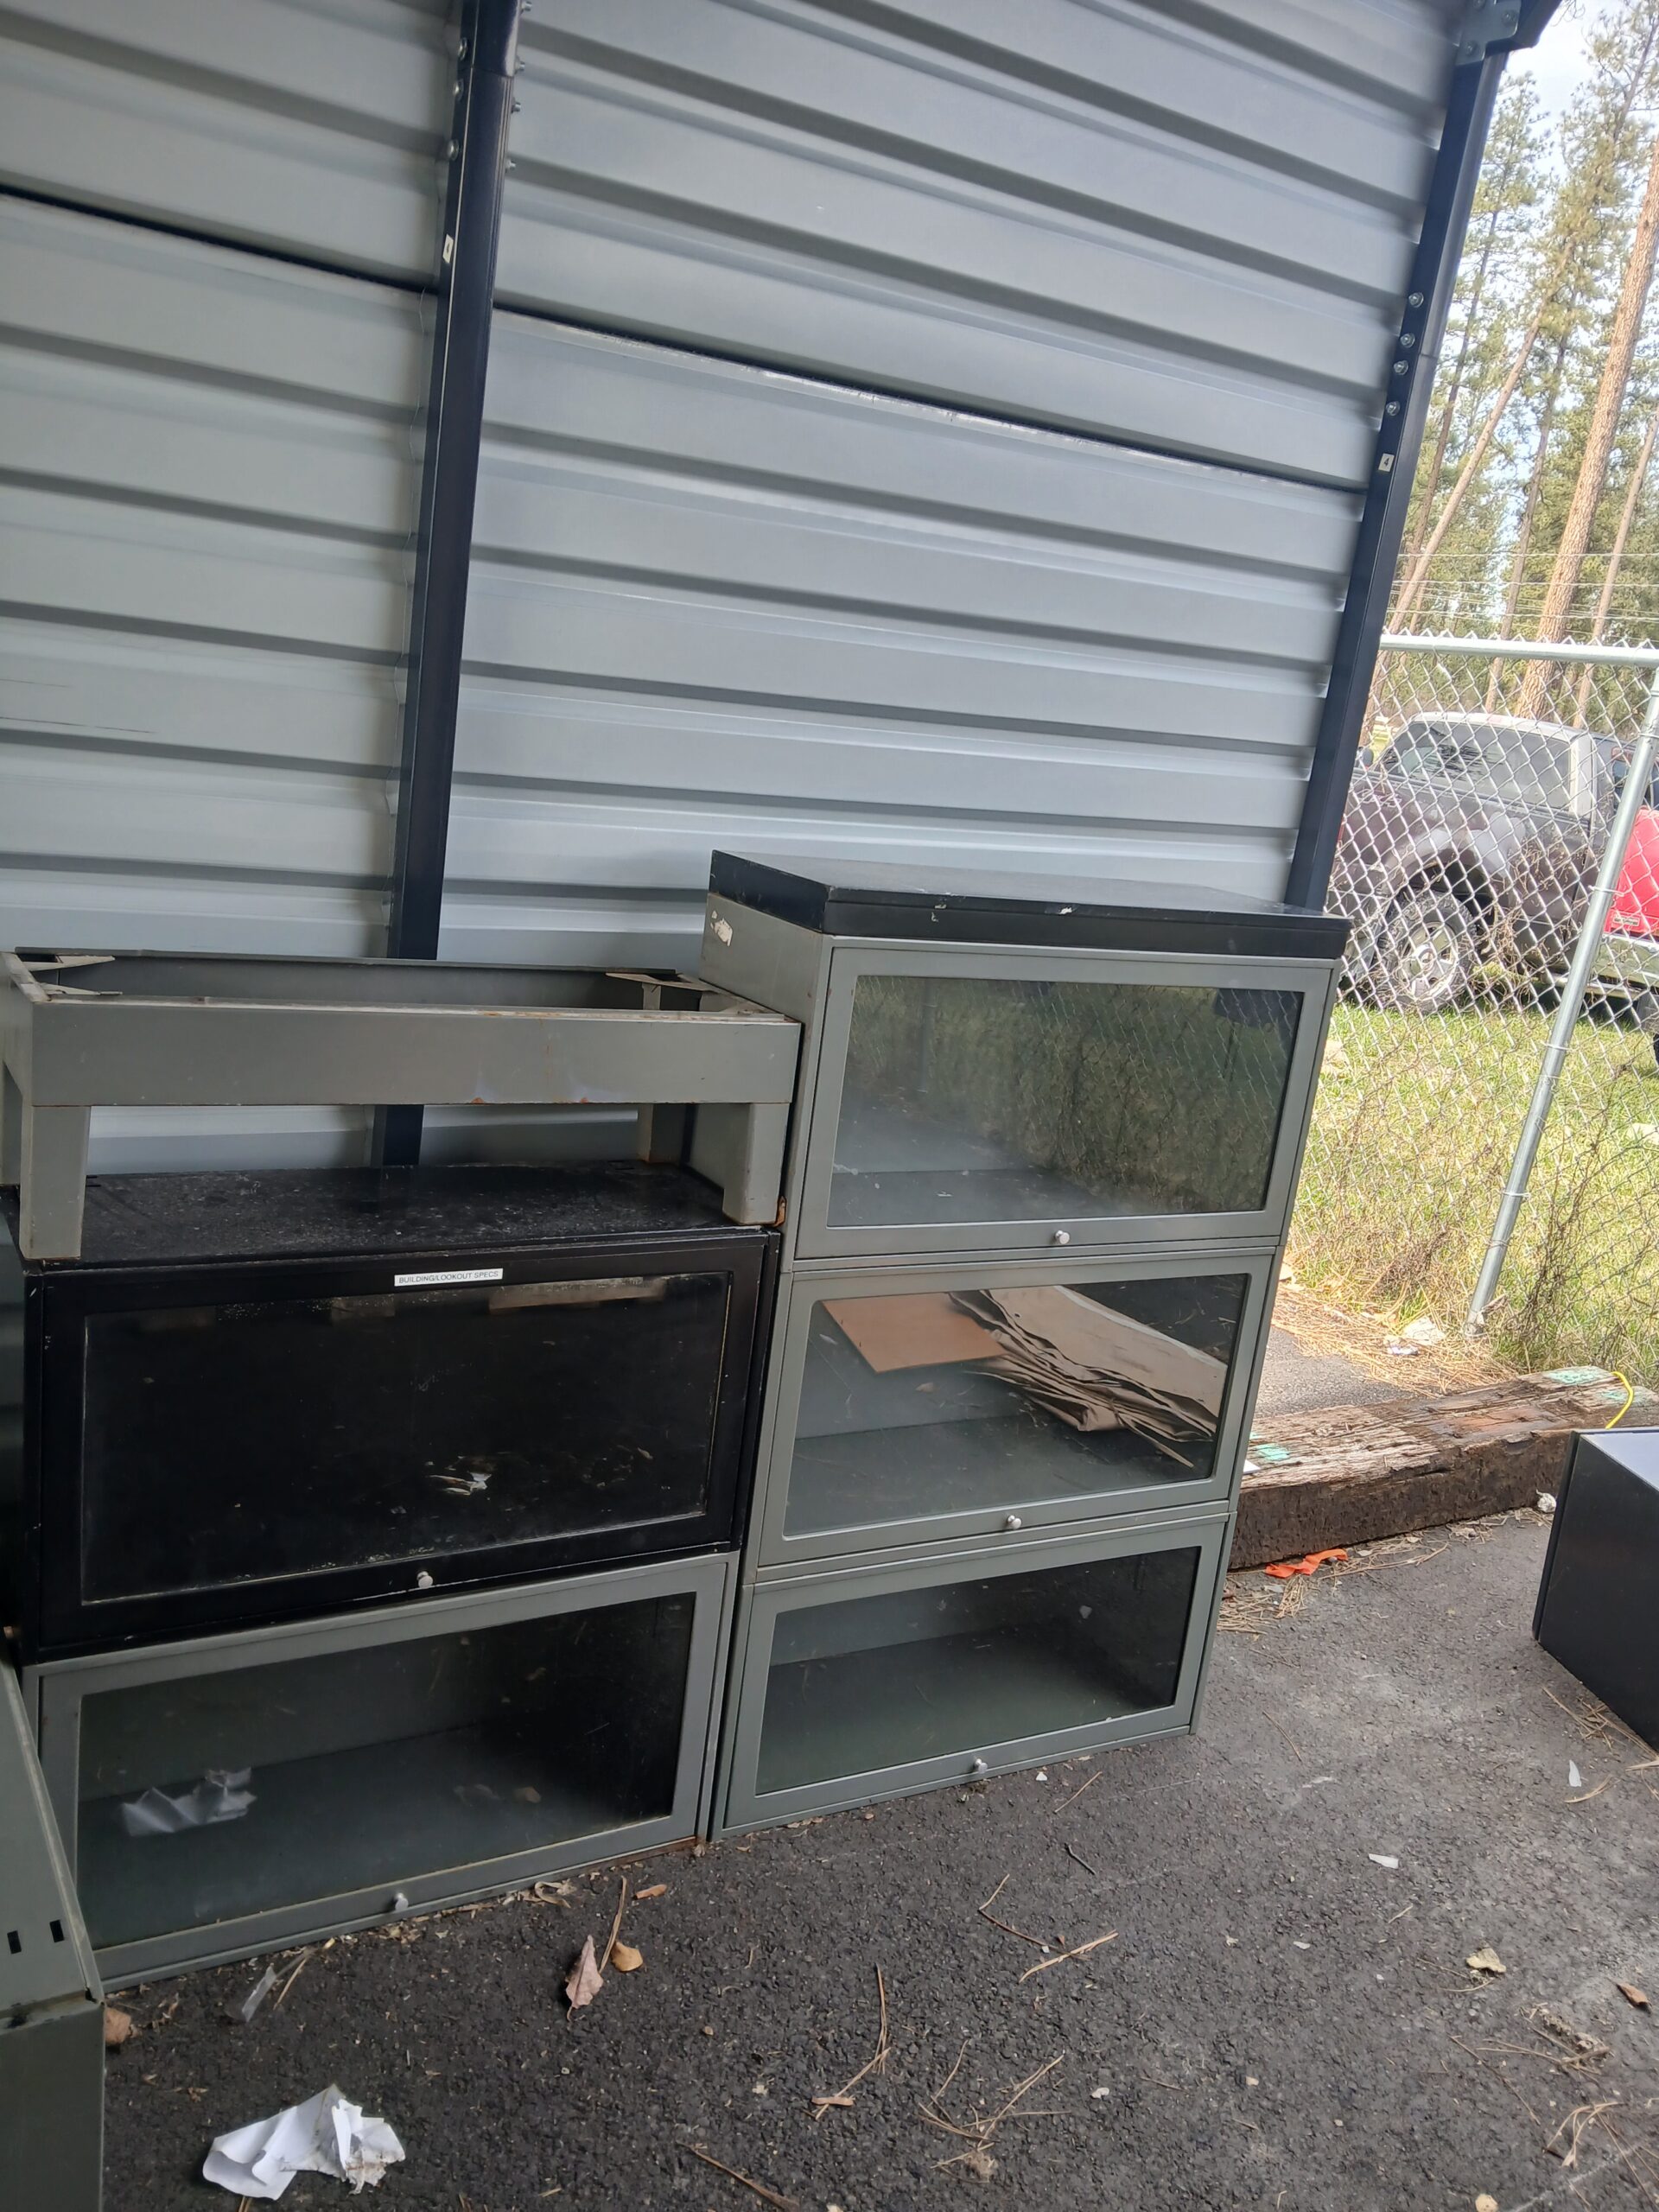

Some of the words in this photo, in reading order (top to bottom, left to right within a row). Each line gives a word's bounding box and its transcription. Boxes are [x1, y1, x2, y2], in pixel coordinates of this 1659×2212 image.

[1383, 457, 1389, 467] 4
[398, 1272, 472, 1284] BUILDING/LOOKOUT
[474, 1270, 499, 1279] SPECS
